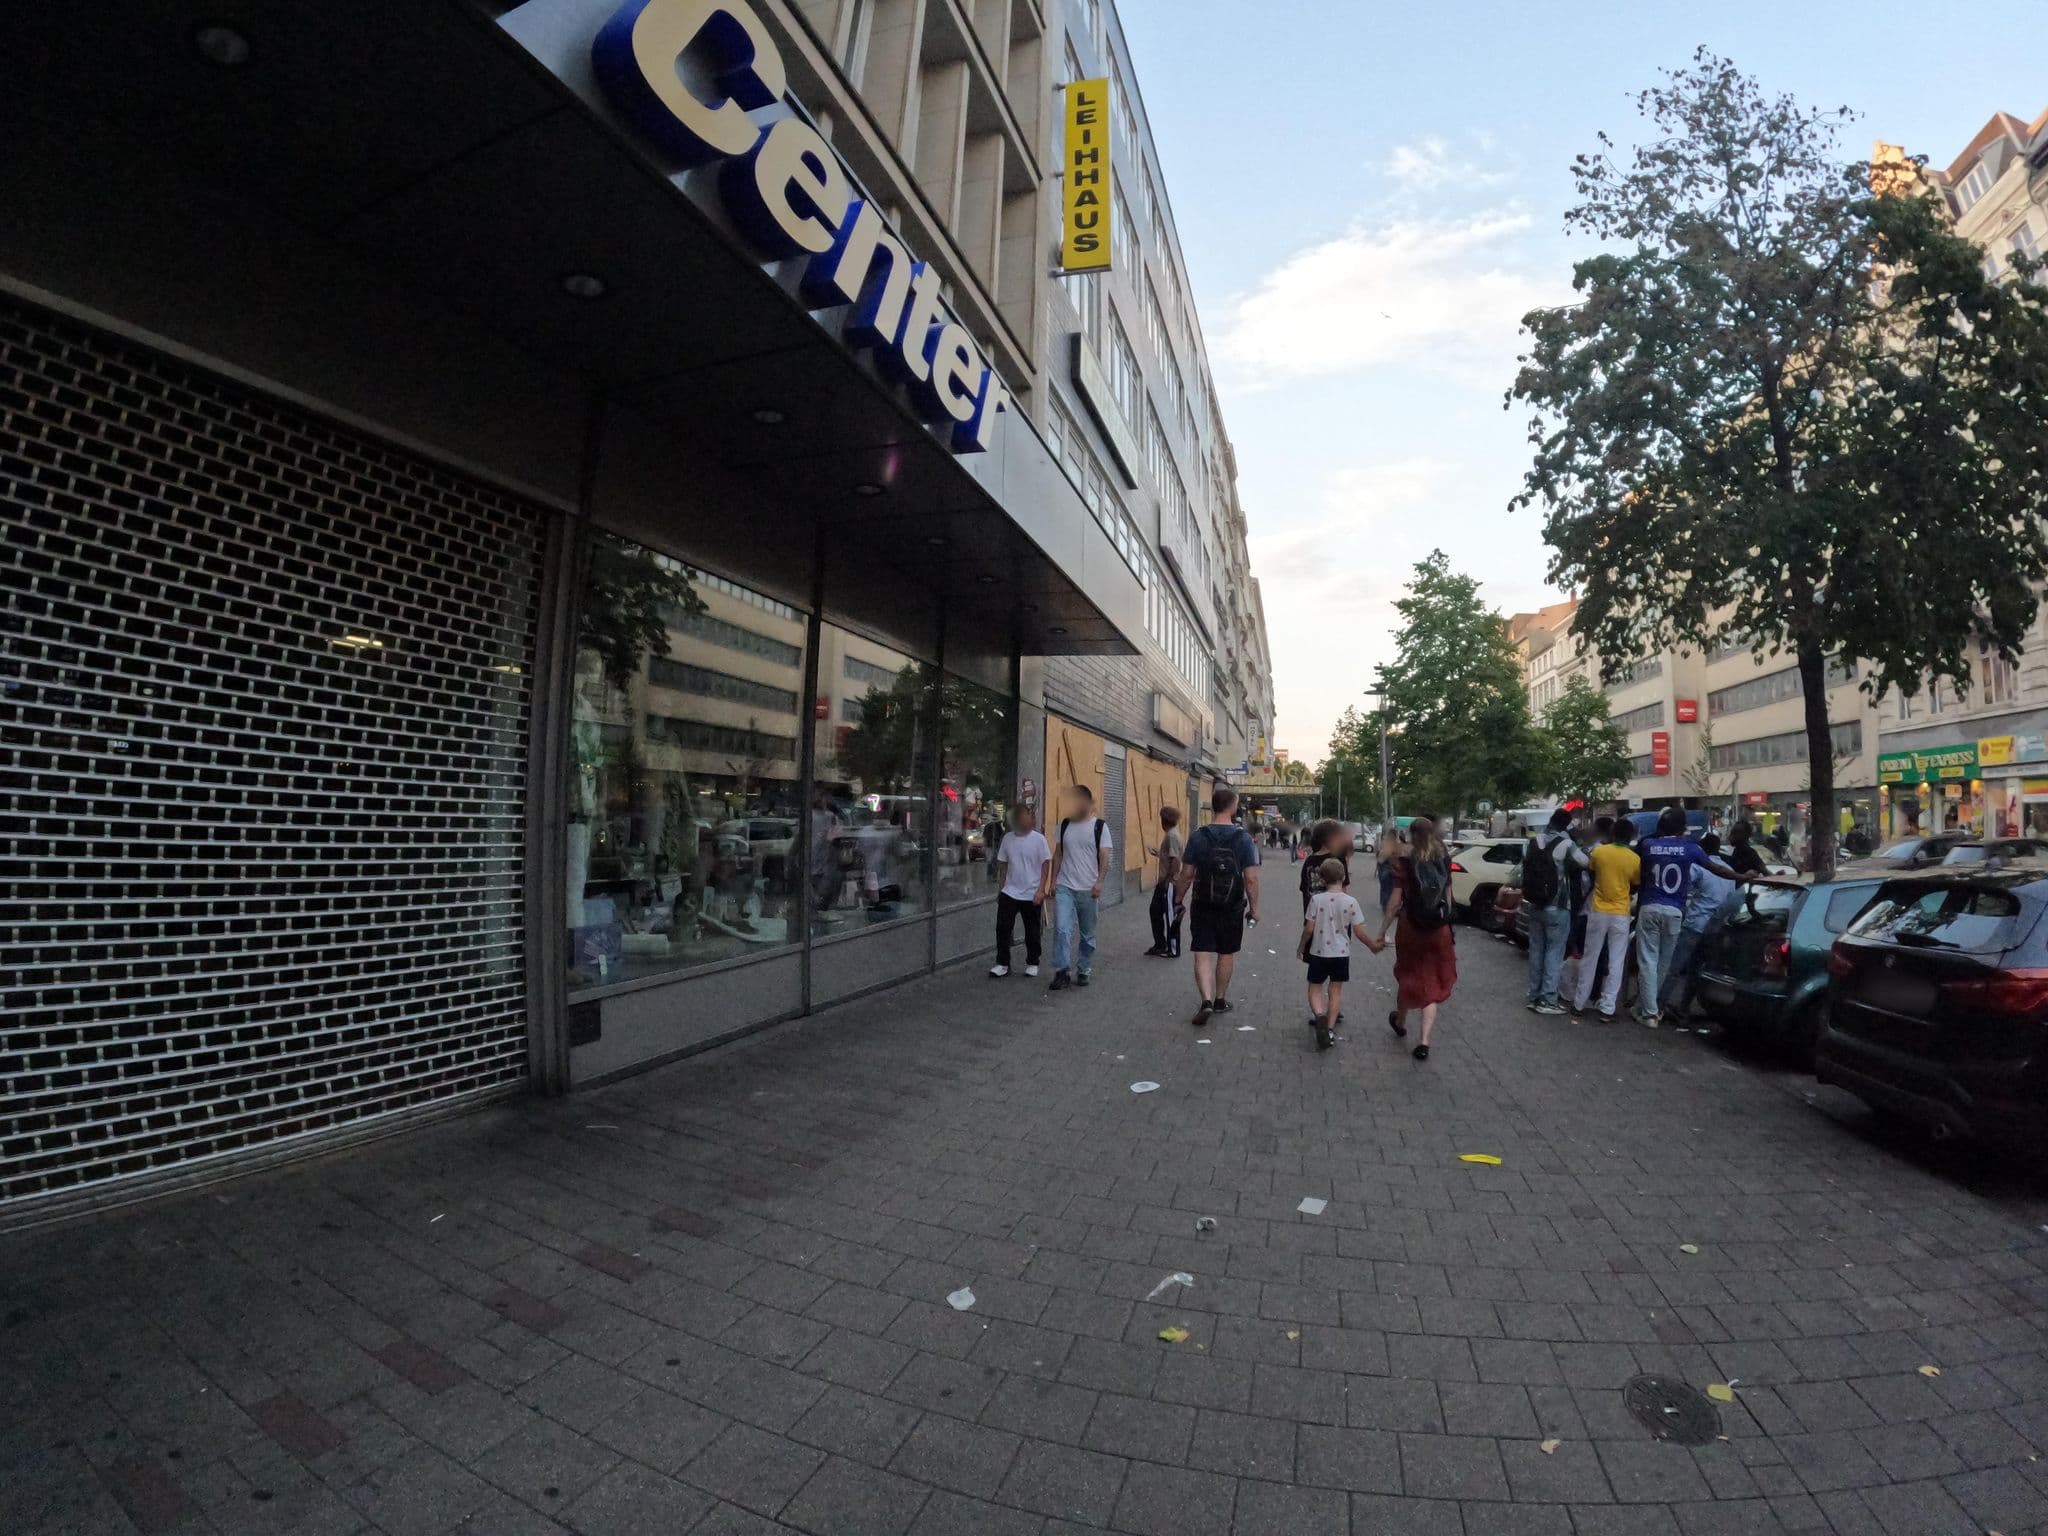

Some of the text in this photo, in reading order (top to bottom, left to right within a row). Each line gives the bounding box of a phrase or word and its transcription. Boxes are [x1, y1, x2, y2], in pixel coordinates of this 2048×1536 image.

[602, 0, 1009, 453] Center
[1073, 92, 1099, 252] LEIHHAUS
[1651, 863, 1682, 894] 10
